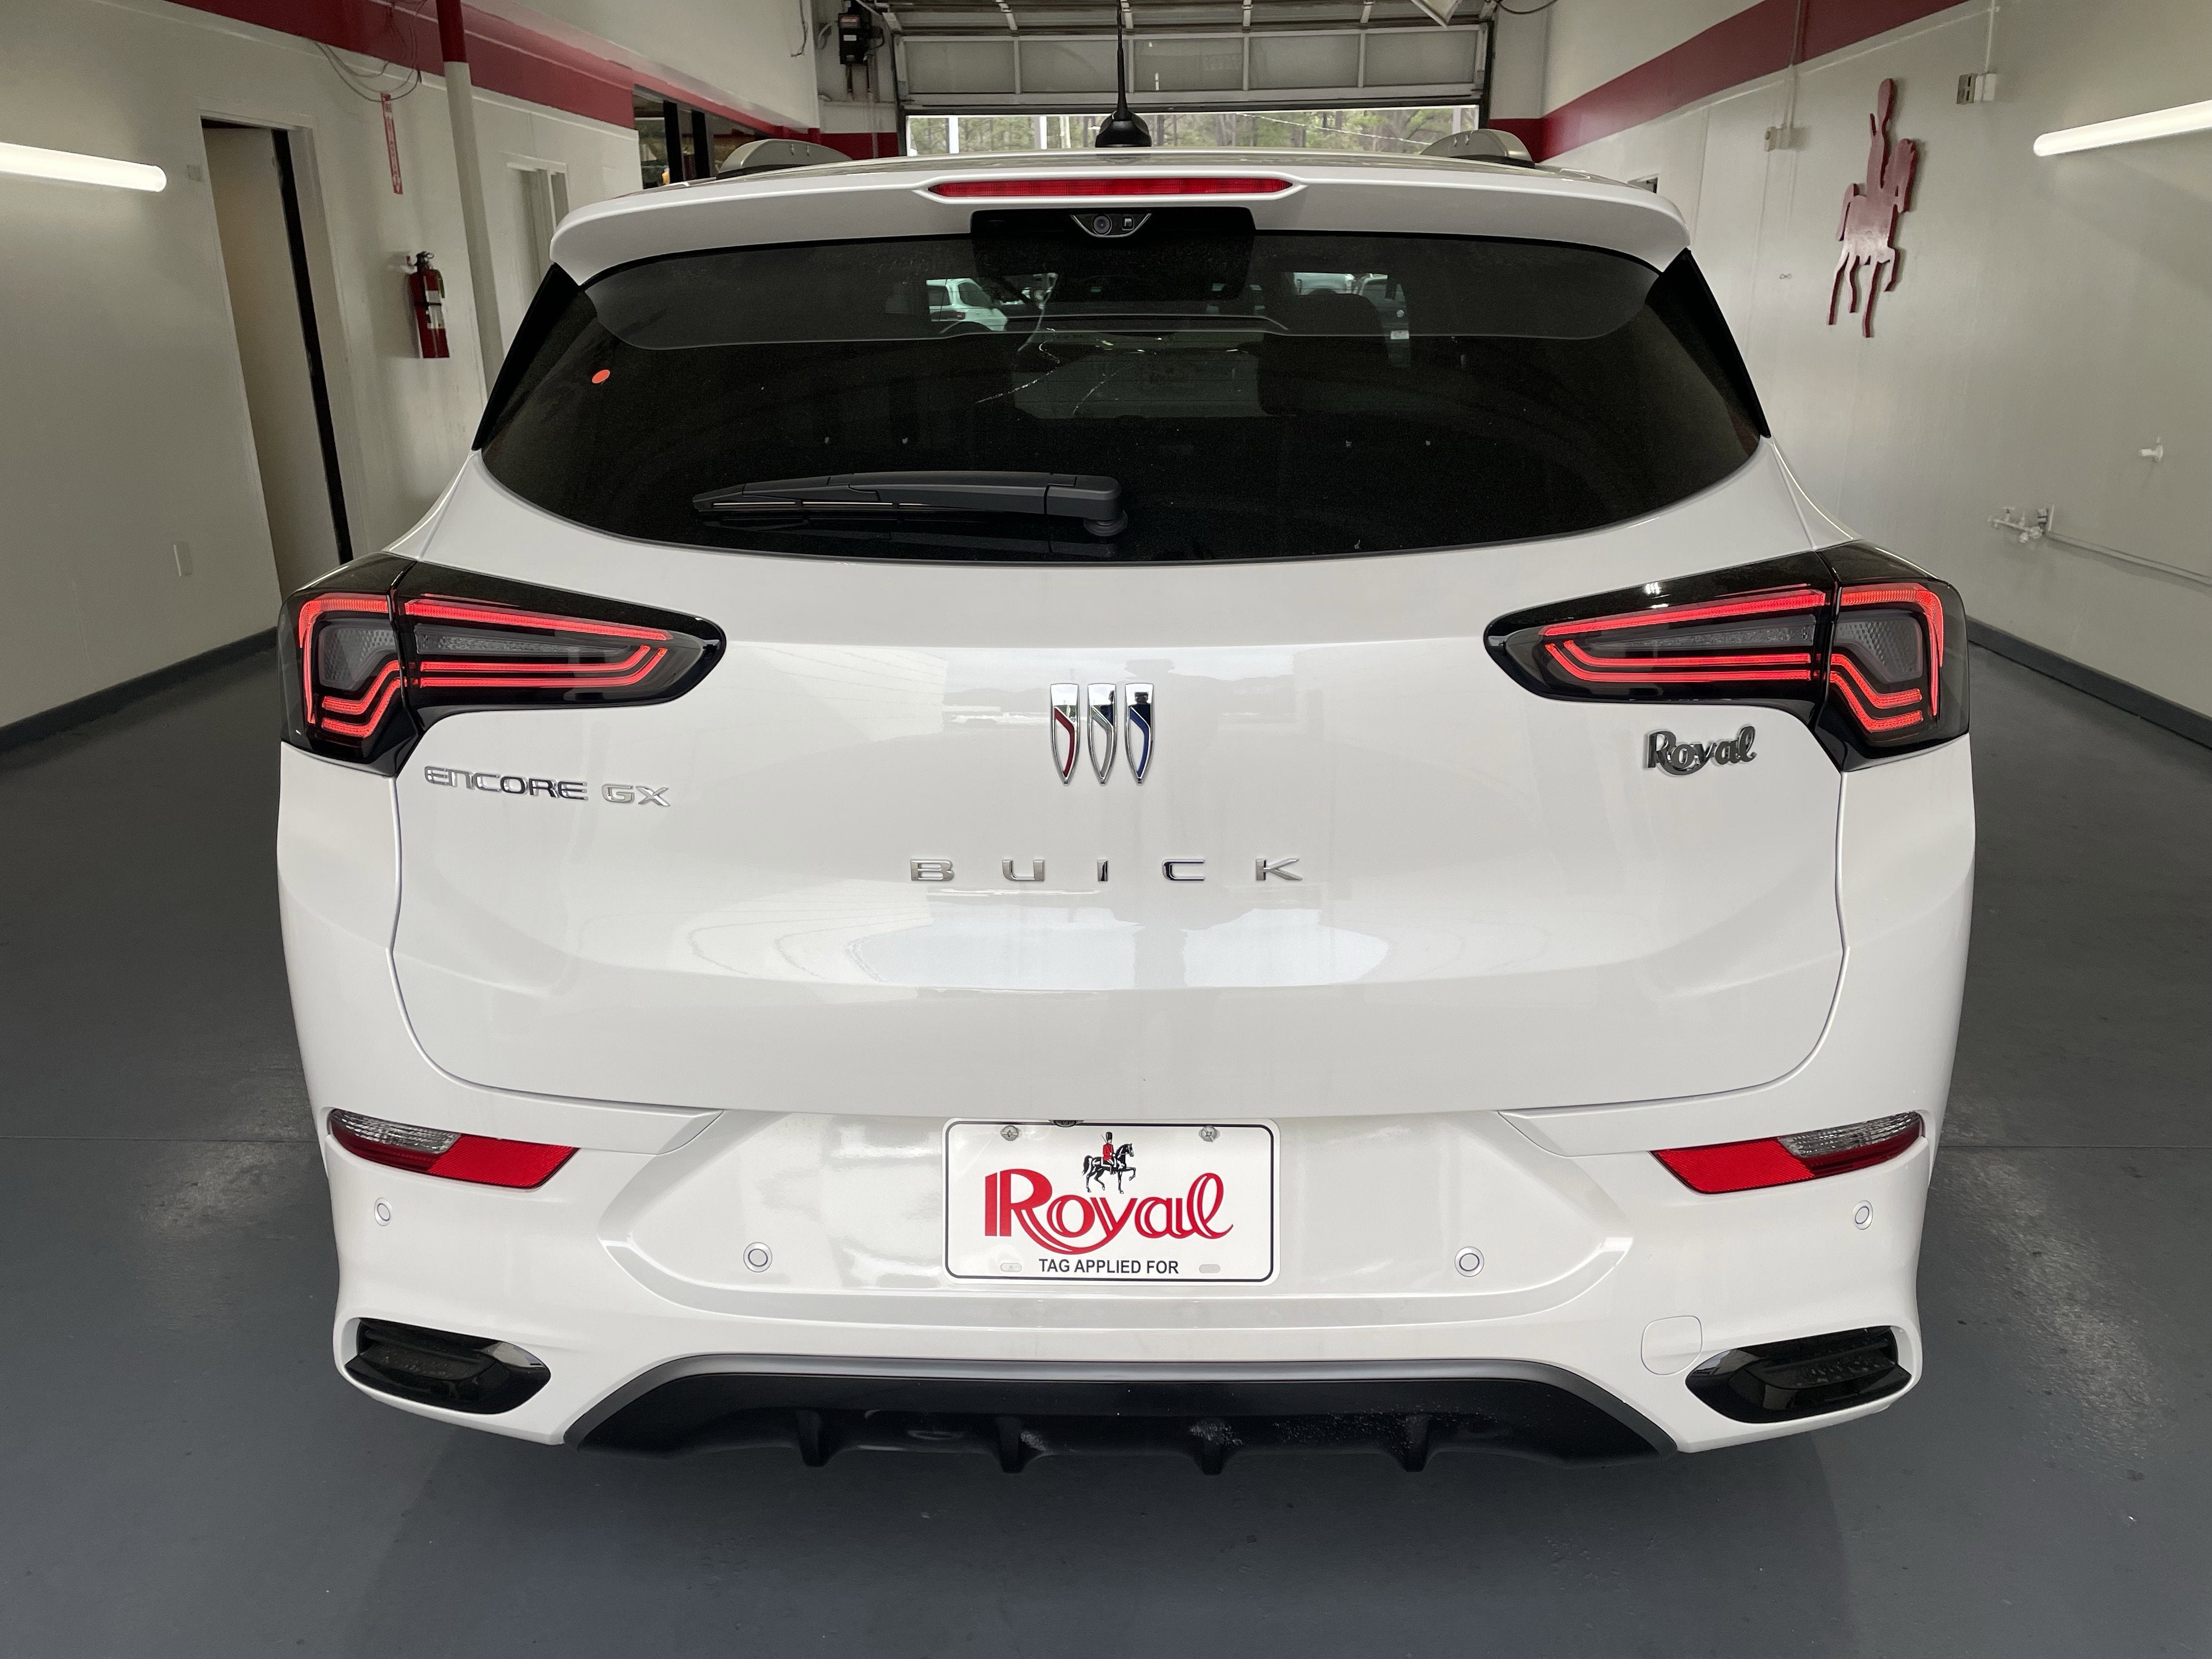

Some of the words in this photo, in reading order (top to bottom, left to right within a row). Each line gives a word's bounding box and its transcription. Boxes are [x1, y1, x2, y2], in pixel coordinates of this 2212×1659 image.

[1644, 724, 1757, 777] Royal
[425, 765, 588, 801] ENCORE
[602, 783, 670, 807] GX
[910, 857, 1302, 881] BUICK
[985, 1169, 1234, 1255] Royal
[1039, 1259, 1070, 1273] TAG
[1074, 1259, 1141, 1274] APPLIED
[1146, 1260, 1179, 1274] FOR
